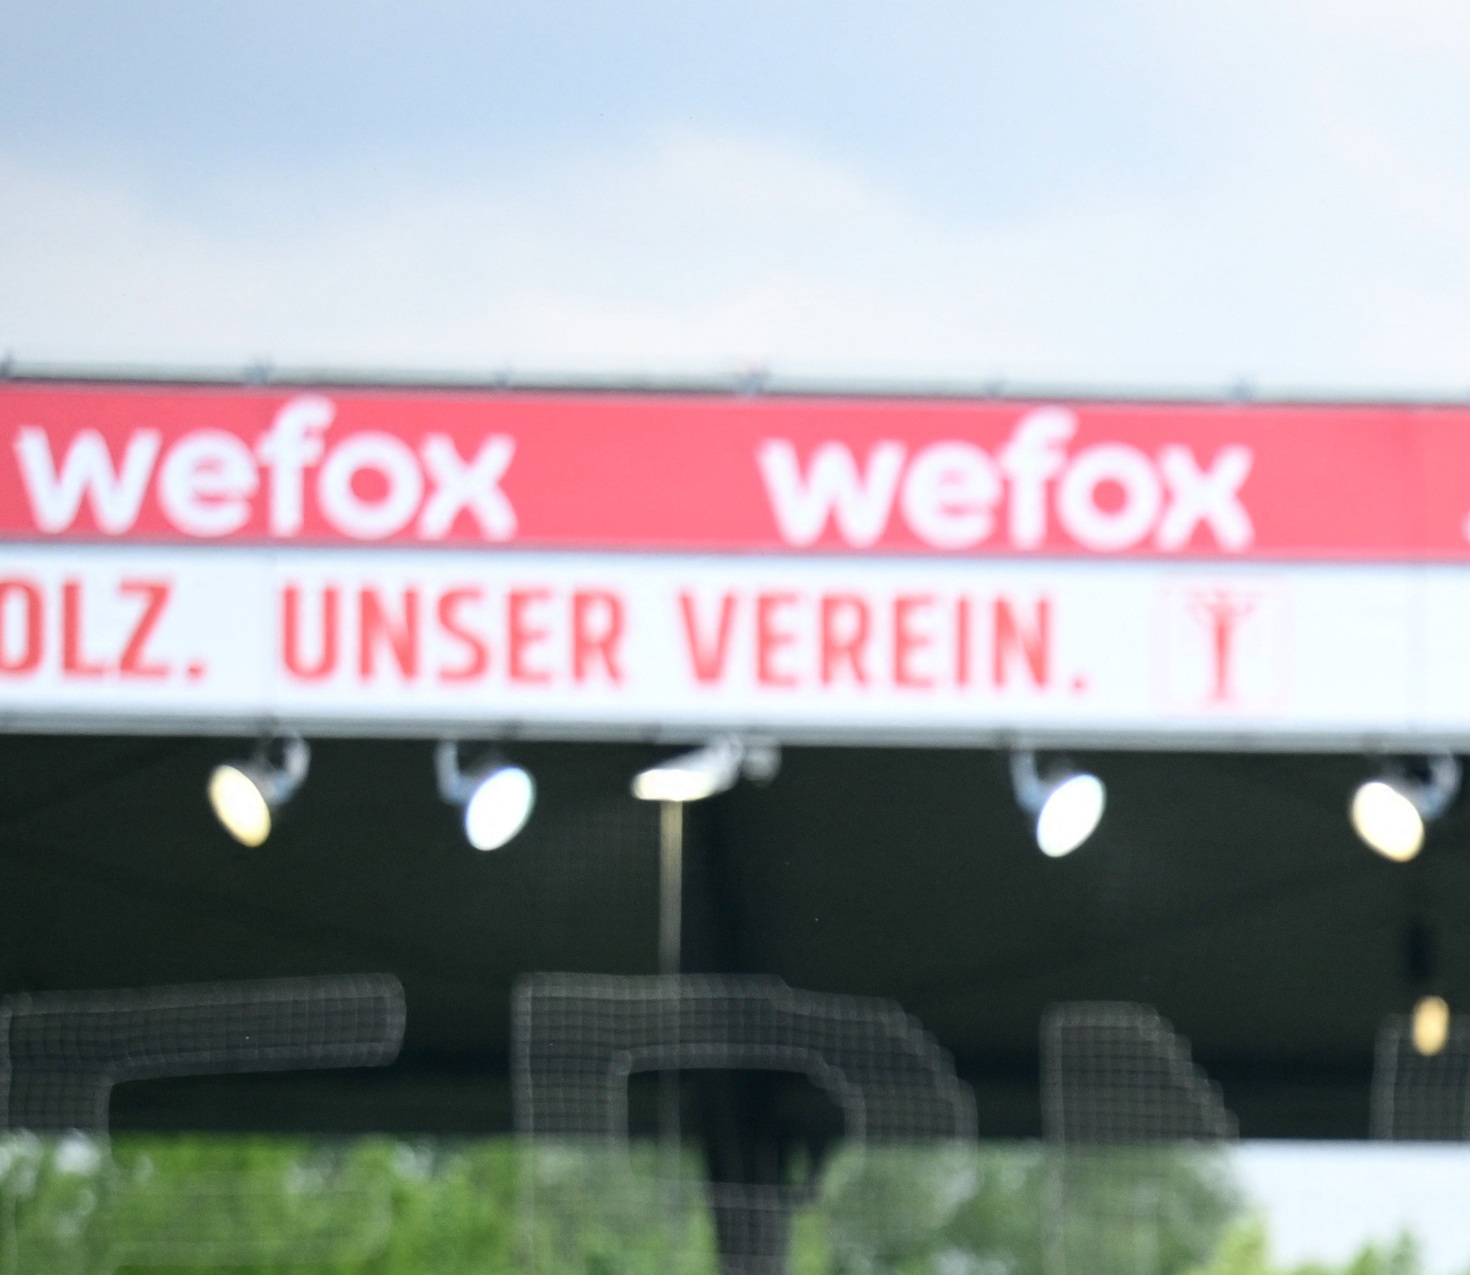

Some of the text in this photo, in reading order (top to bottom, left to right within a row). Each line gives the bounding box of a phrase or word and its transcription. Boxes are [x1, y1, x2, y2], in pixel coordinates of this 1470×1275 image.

[16, 395, 517, 539] wefox
[756, 404, 1254, 552] wefox
[280, 582, 625, 690] UNSER
[680, 586, 1088, 694] VEREIN.
